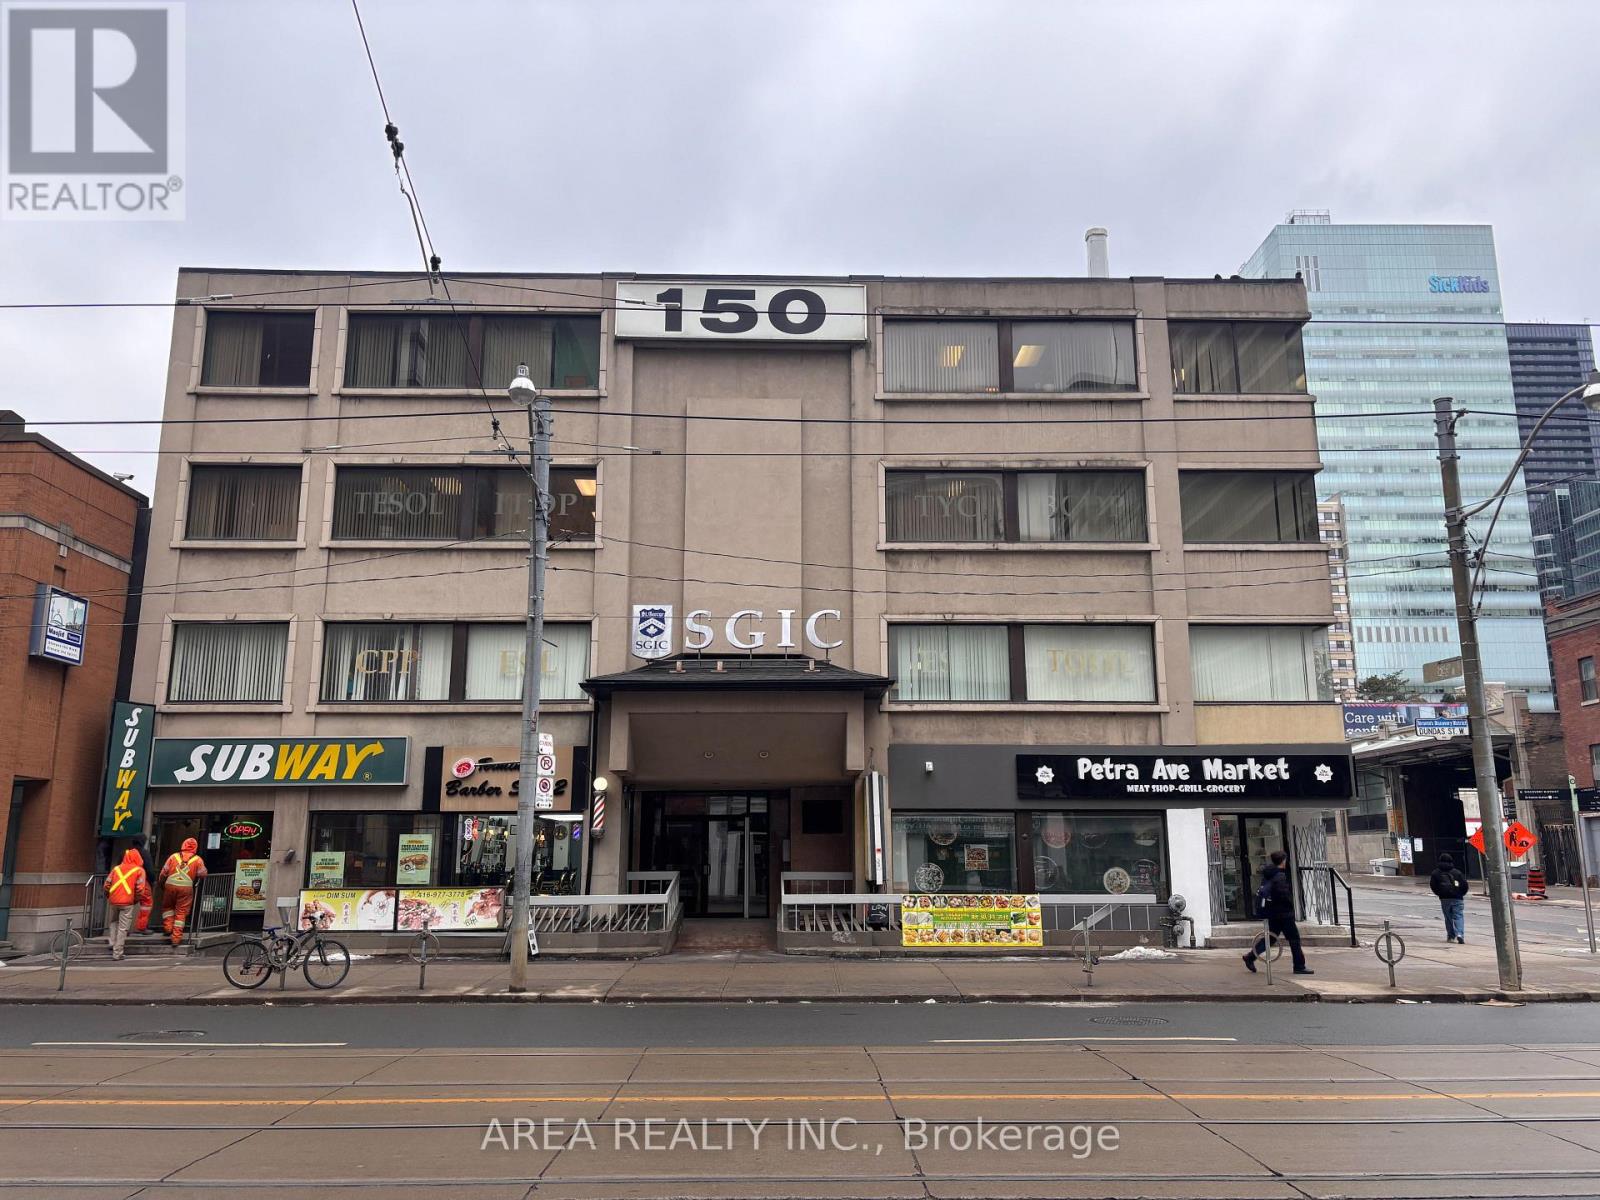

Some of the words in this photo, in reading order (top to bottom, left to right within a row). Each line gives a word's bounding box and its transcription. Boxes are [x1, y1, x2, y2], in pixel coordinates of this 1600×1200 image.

[1428, 273, 1490, 293] SickKids
[655, 287, 827, 335] 150
[353, 491, 444, 516] TESOL
[684, 609, 844, 650] SGIC
[635, 640, 668, 650] SGIC
[1344, 711, 1375, 724] Care
[1377, 711, 1406, 724] with
[1419, 727, 1446, 736] DUNDAS
[1458, 727, 1464, 735] W
[1076, 757, 1139, 781] Petra
[1152, 757, 1190, 781] Ave
[1202, 756, 1290, 781] Market
[445, 779, 503, 797] Barber
[553, 778, 569, 796] 2
[1126, 784, 1150, 793] MEAT
[1151, 783, 1246, 794] SHOP-GRILL-GROCERY
